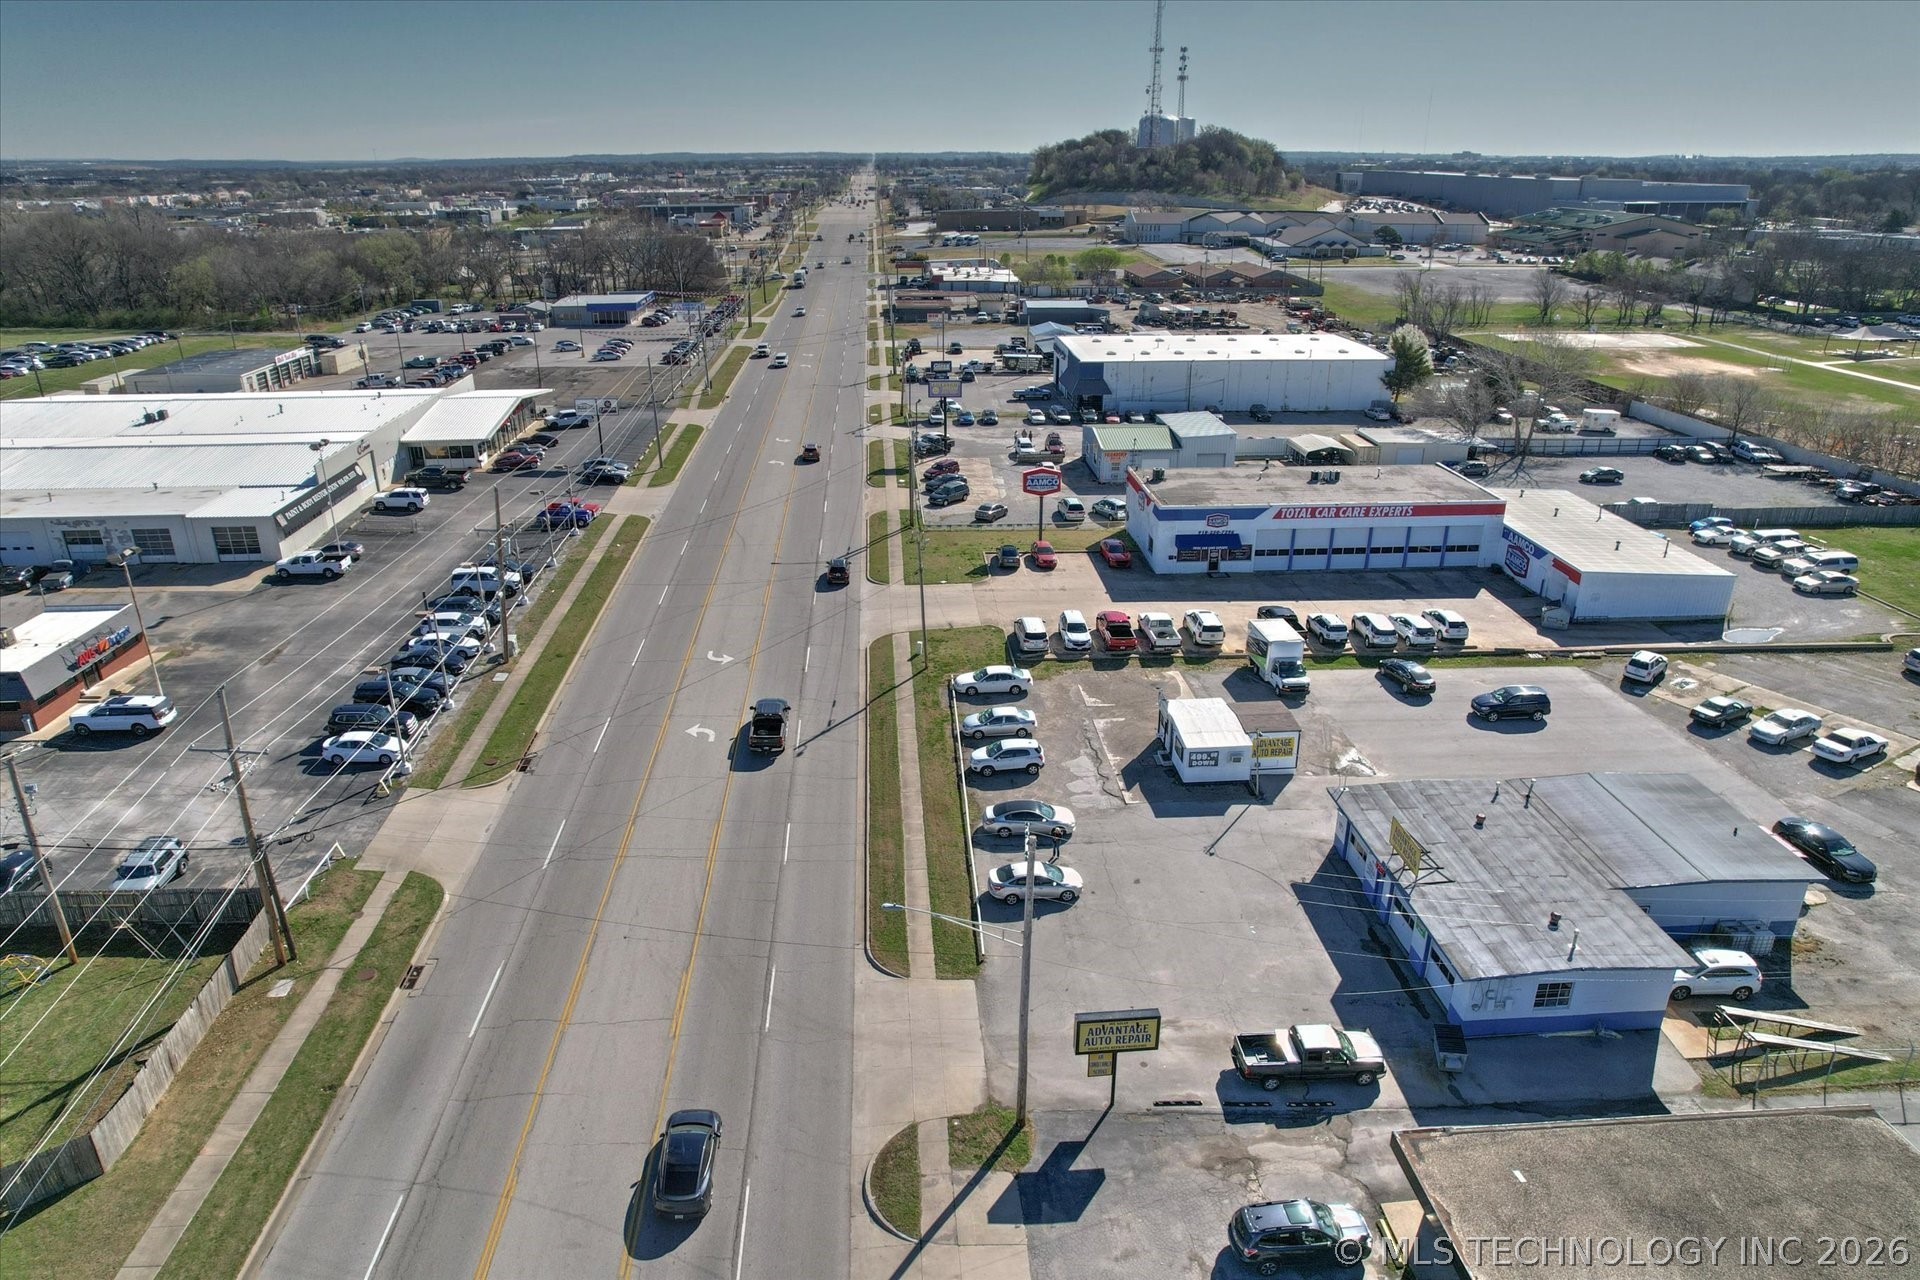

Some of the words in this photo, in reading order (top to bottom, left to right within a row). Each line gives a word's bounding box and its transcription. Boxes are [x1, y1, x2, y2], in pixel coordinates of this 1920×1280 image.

[1026, 479, 1060, 487] AAMCO
[1280, 507, 1312, 519] TOTAL
[1315, 507, 1337, 519] CAR
[1339, 506, 1367, 518] CARE
[1368, 505, 1414, 517] EXPERTS
[1508, 531, 1535, 555] AAMCO
[76, 647, 97, 668] AVIS
[1270, 747, 1293, 757] REPAIR
[1087, 1024, 1149, 1037] ADVANTAGE
[1084, 1036, 1112, 1047] AUTO
[1115, 1033, 1152, 1045] REPAIR
